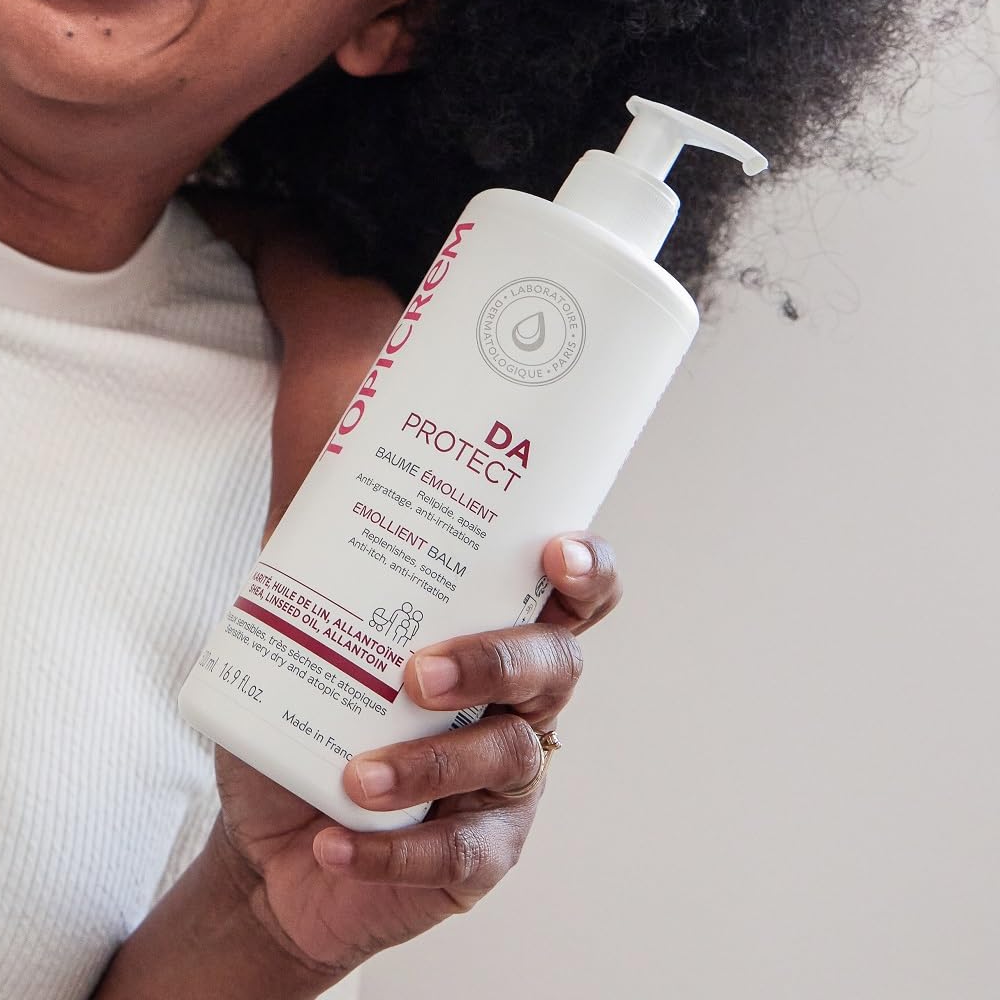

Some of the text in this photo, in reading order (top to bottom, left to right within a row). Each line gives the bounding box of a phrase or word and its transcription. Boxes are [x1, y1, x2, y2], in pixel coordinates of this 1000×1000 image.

[483, 299, 543, 380] DERMATOLOGIQUE
[510, 284, 578, 330] LABORATOIRE
[552, 341, 577, 372] PARIS
[400, 411, 522, 493] PROTECT
[483, 420, 531, 470] DA
[355, 472, 480, 551] Anti-grattage, anti-irritations
[375, 446, 499, 524] BAUME ÉMOLLIENT
[352, 501, 467, 578] EMOLLIENT BALM
[361, 527, 457, 592] Replenishes, soothes
[456, 516, 487, 539] apaise
[347, 536, 450, 604] Anti-itch, anti-irritation
[264, 591, 301, 618] LINSEED
[301, 613, 321, 634] OIL,
[322, 627, 388, 673] ALLANTOIN
[271, 580, 298, 602] HUILE
[295, 594, 313, 610] DE
[310, 603, 331, 625] LIN,
[331, 618, 405, 668] ALLANTOÏNE
[218, 662, 242, 685] 16.9
[251, 640, 271, 658] very
[270, 652, 288, 668] dry
[286, 663, 308, 680] and
[306, 675, 341, 701] atopic
[340, 697, 362, 716] skin
[268, 635, 288, 653] très
[323, 671, 337, 684] et
[336, 680, 388, 716] atopiques
[281, 709, 353, 763] Made in Franc
